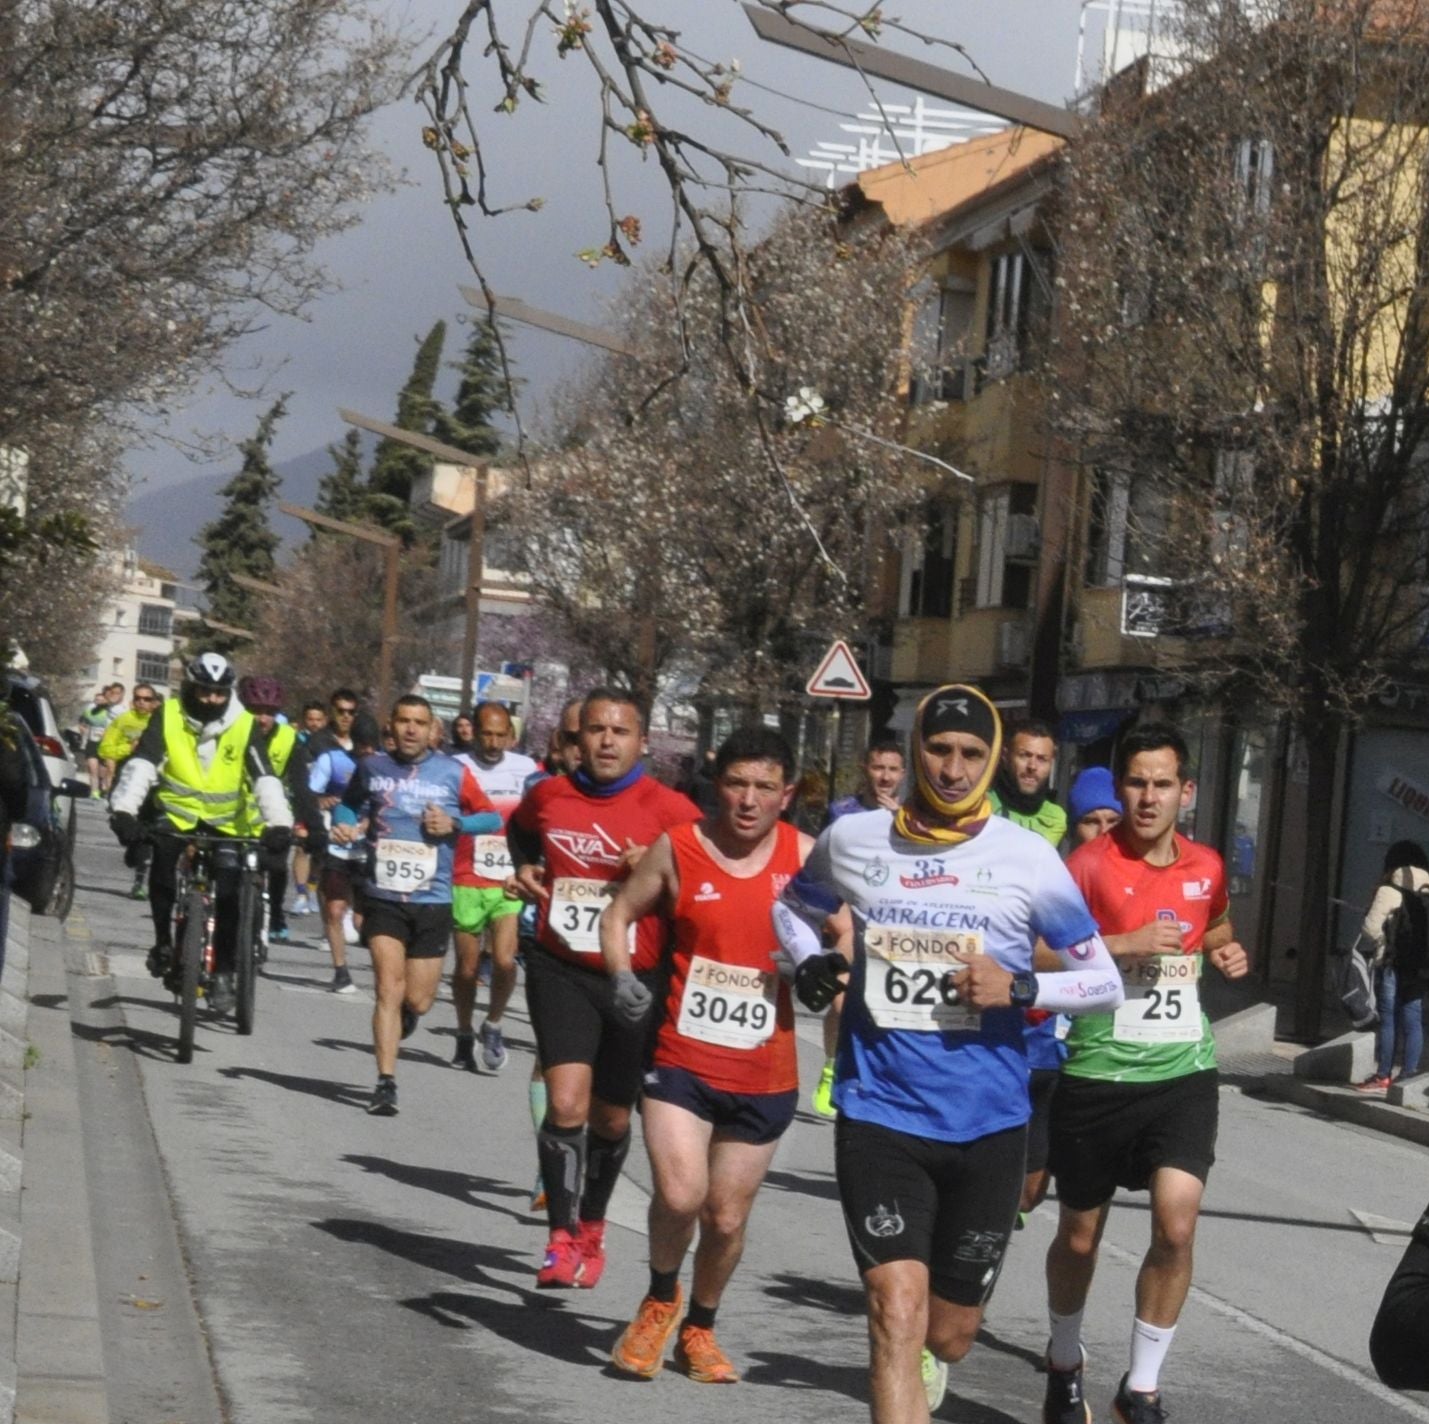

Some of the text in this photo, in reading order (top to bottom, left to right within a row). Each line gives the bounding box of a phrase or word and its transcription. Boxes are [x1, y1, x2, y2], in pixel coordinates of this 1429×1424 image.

[386, 859, 425, 881] 955
[865, 906, 992, 932] MARACENA
[890, 936, 961, 954] FONDO
[707, 966, 764, 990] FONDO
[687, 991, 768, 1030] 3049
[1141, 990, 1183, 1021] 25
